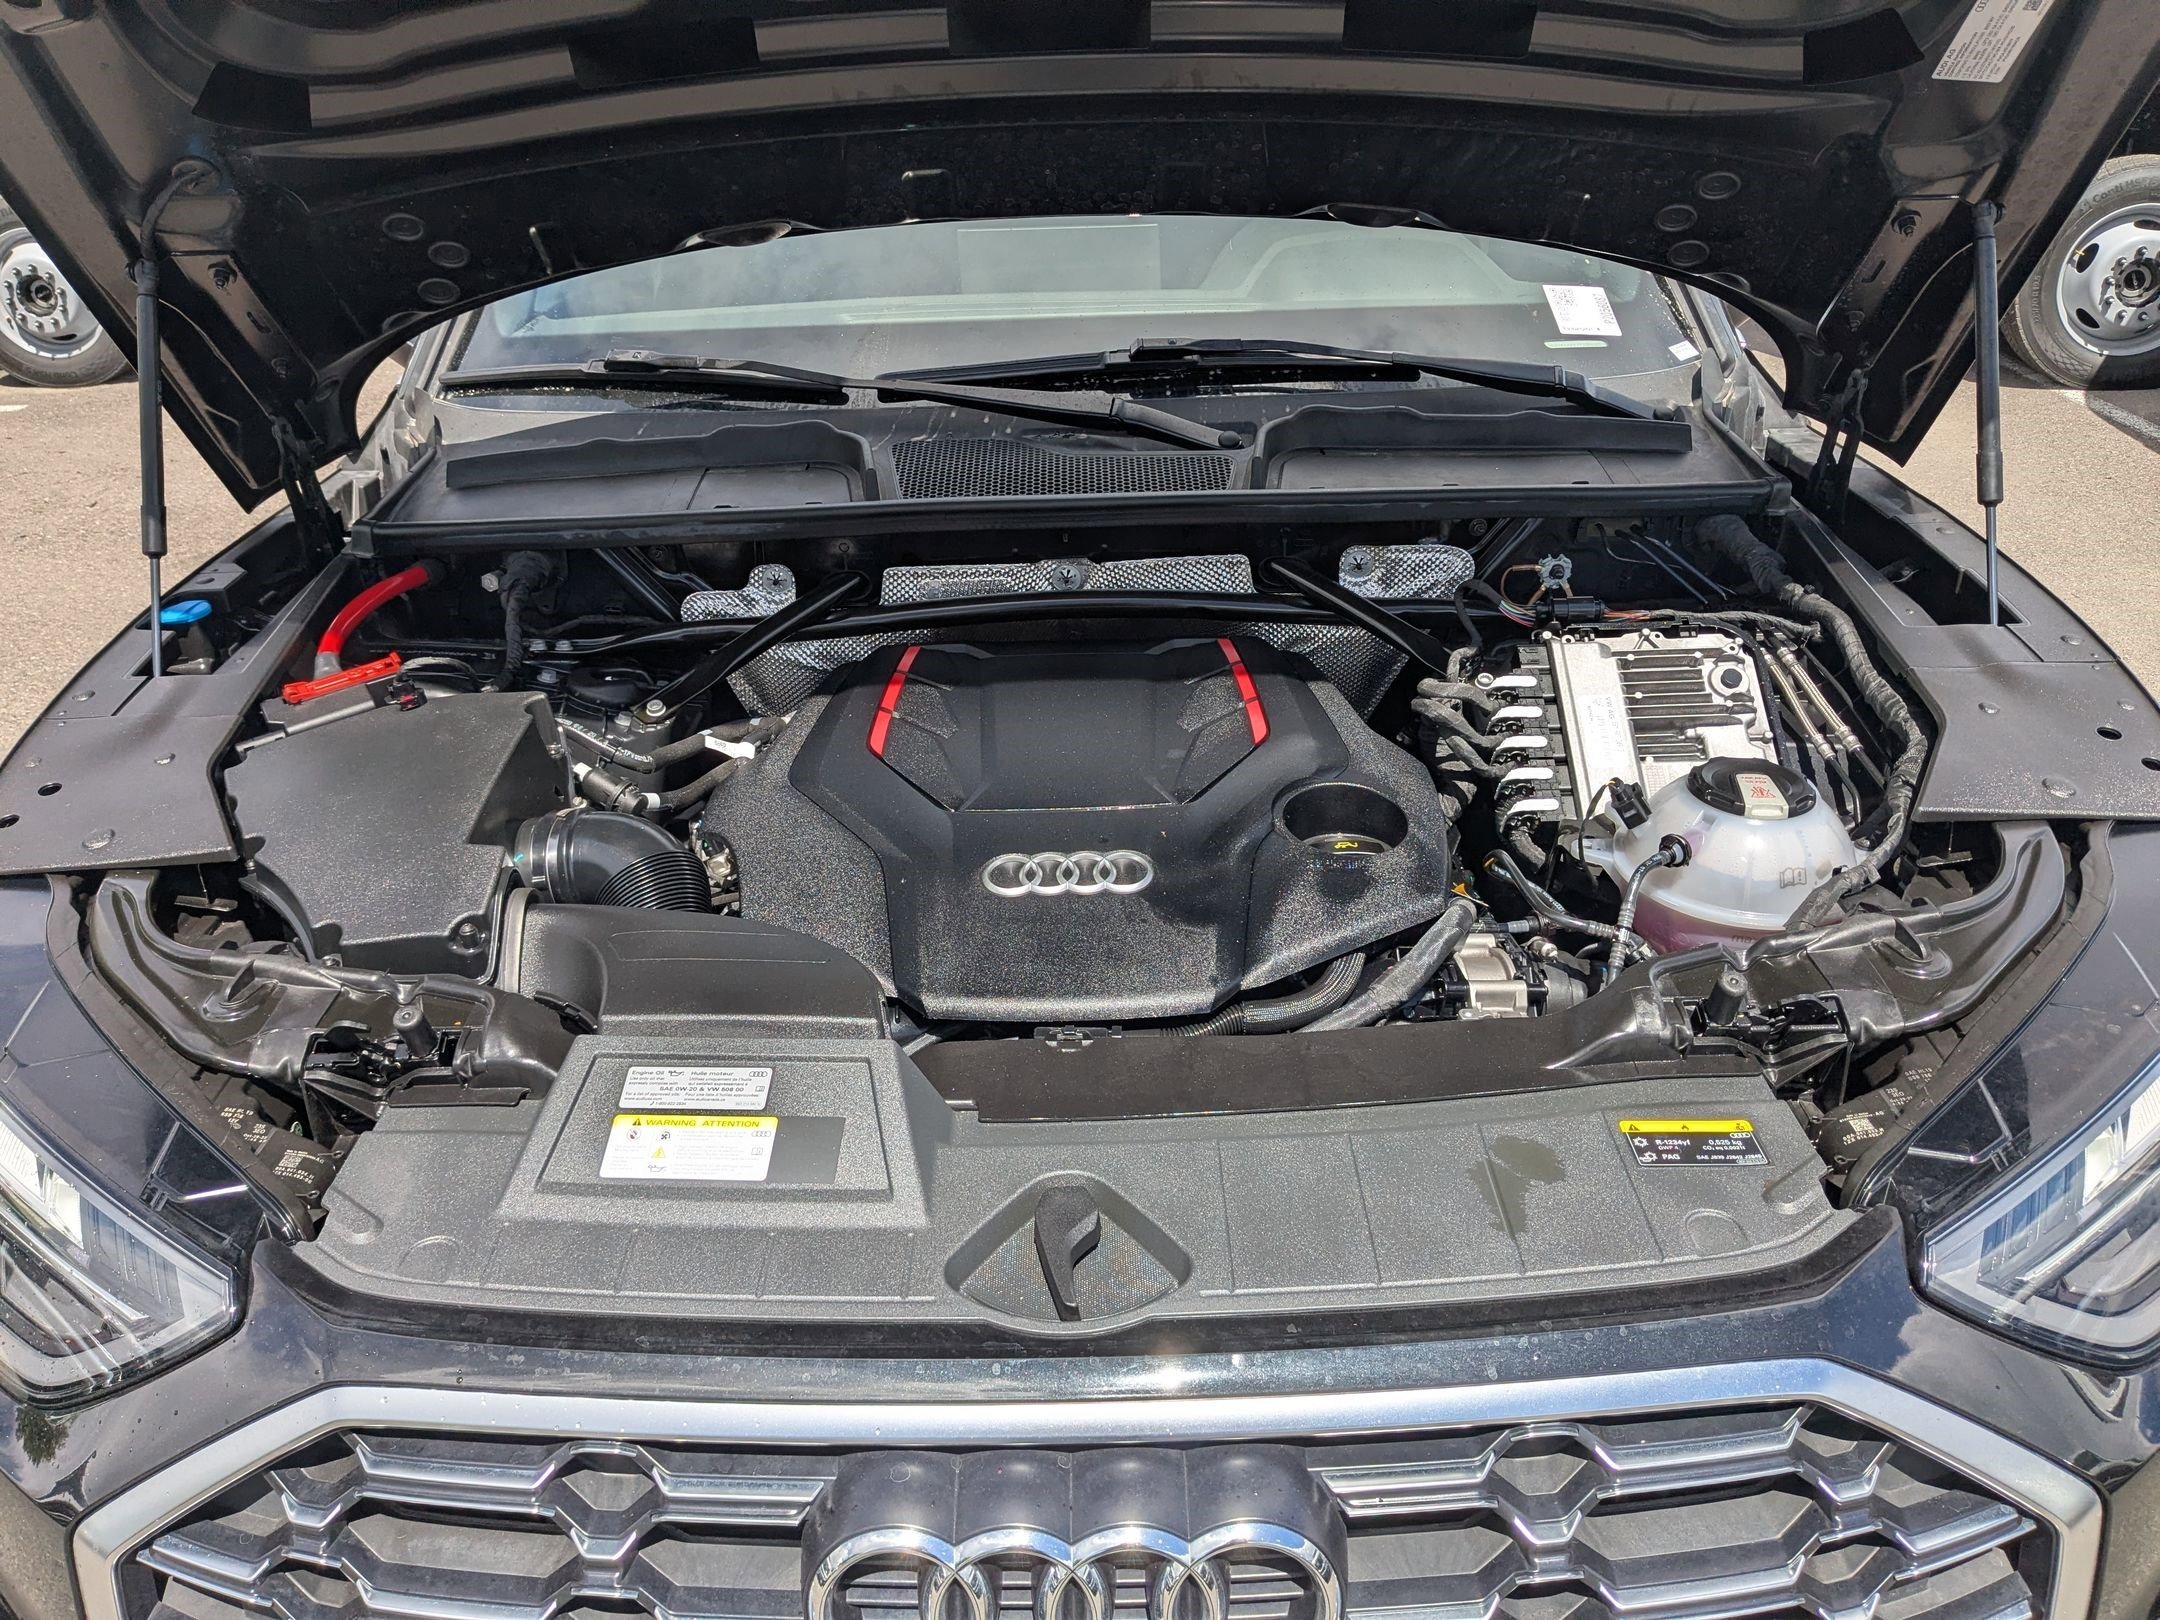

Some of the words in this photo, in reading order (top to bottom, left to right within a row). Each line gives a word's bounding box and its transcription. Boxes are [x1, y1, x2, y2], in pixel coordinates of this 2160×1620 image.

[1935, 60, 1950, 76] AUDI
[1946, 48, 1957, 59] AG
[646, 1119, 697, 1127] WARNING
[702, 1120, 760, 1128] ATTENTION
